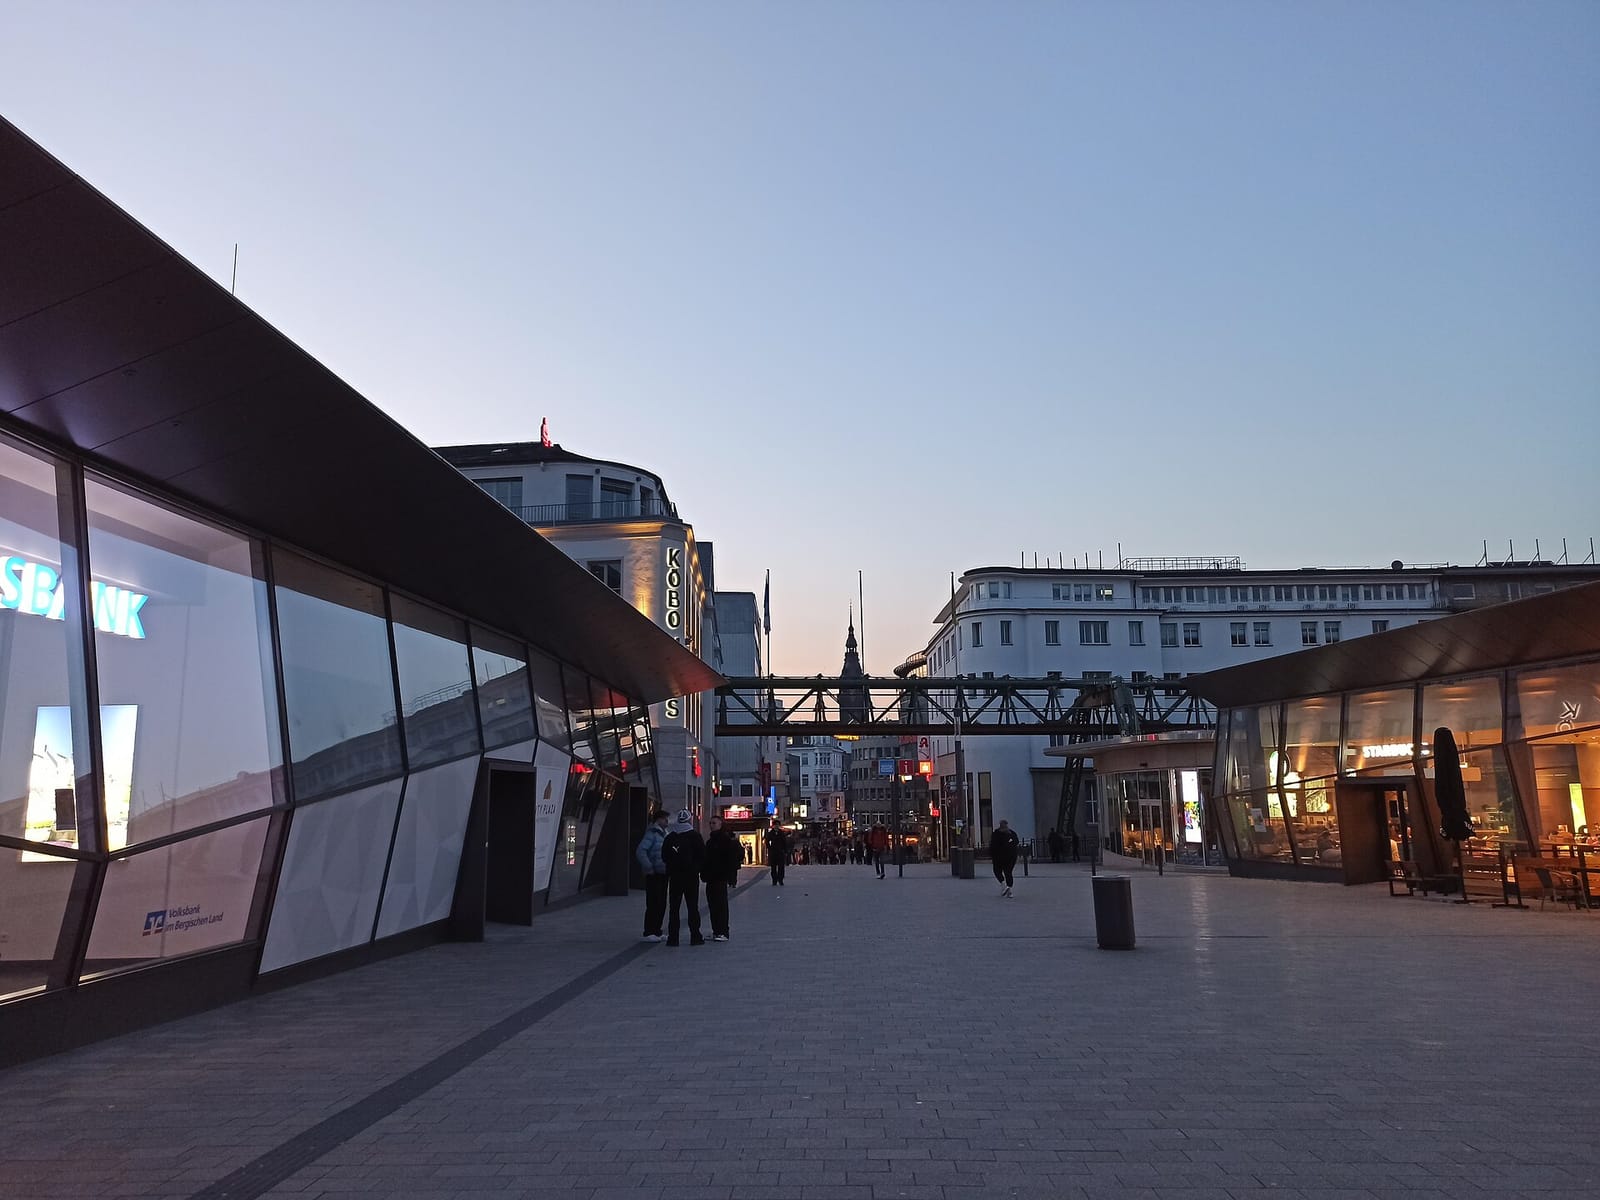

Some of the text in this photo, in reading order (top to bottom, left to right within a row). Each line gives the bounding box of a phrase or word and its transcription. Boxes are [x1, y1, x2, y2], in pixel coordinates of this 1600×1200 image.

[168, 904, 201, 918] Volksbank
[175, 916, 209, 931] Bergischen
[208, 911, 224, 924] Land
